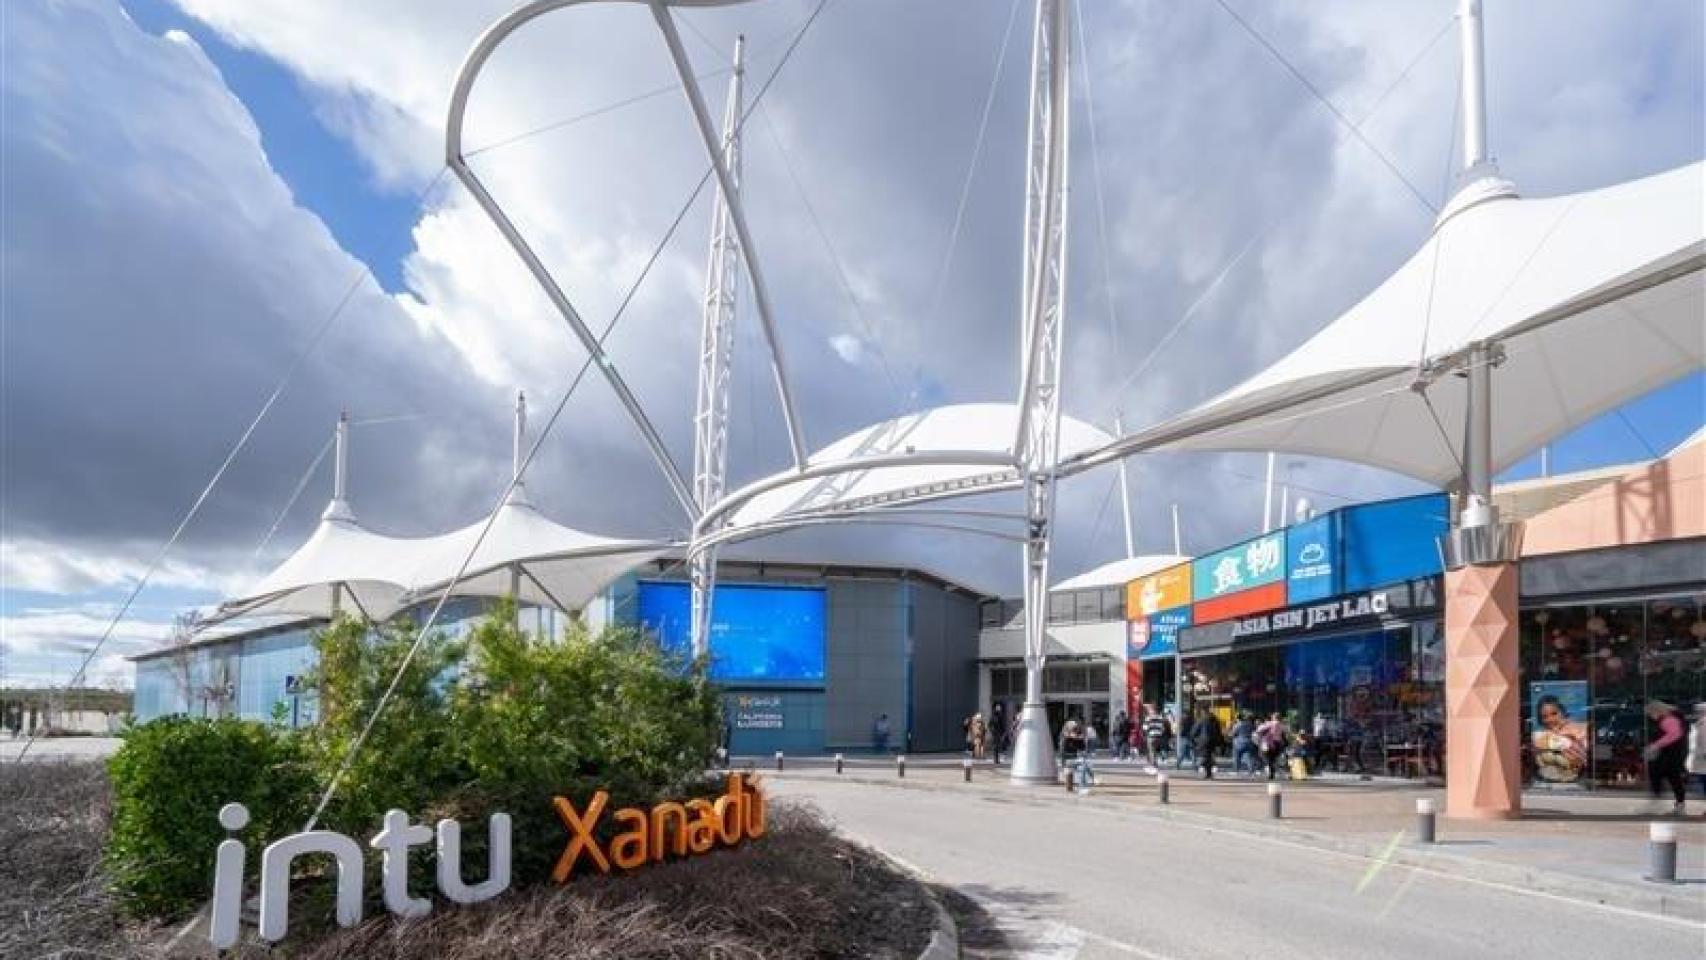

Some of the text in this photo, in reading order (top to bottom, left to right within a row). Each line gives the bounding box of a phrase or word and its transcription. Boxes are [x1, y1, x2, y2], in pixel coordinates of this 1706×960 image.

[1232, 616, 1269, 637] ASIA
[1304, 603, 1339, 629] JET
[210, 803, 512, 949] intu
